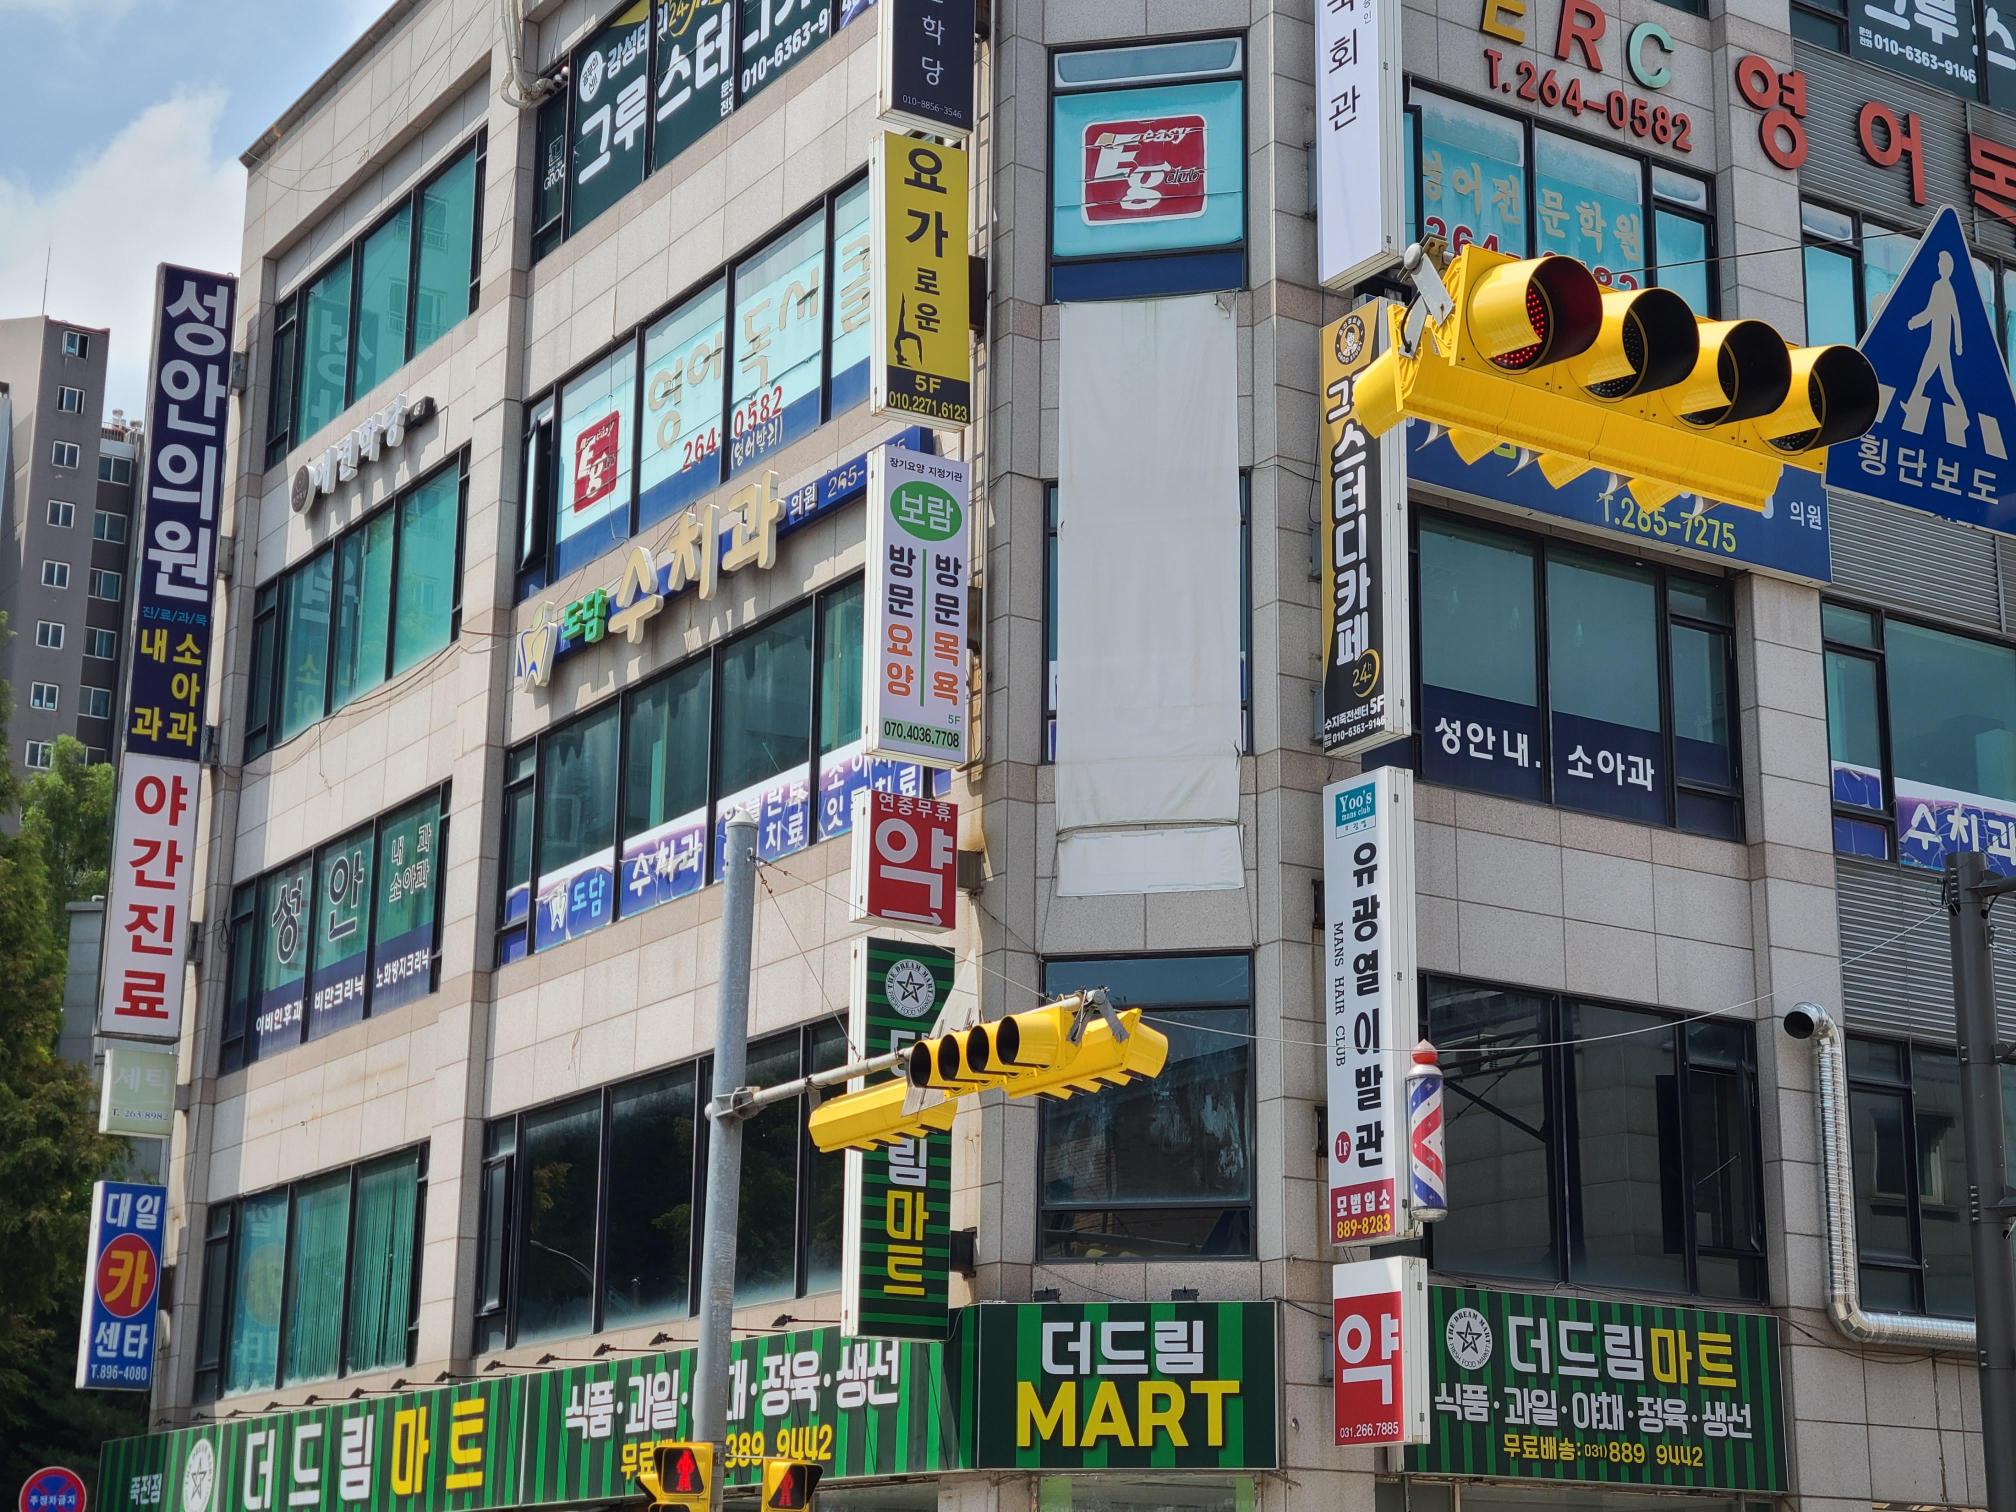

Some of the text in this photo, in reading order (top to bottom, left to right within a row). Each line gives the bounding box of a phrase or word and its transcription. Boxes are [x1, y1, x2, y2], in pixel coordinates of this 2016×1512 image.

[1874, 34, 1977, 85] 010-6363-9146
[902, 95, 962, 118] 010-8856-3546
[1484, 48, 1692, 152] T.264-0582
[915, 375, 942, 394] 5F
[888, 391, 968, 422] 010.2271.6123
[148, 281, 229, 602] 성안의원
[890, 457, 963, 483] 장기요양 지정기관
[1858, 434, 1999, 505] 횡단보도
[790, 483, 817, 518] 의원
[899, 490, 953, 533] 보람
[1328, 371, 1372, 666] 그스터디카페
[1790, 500, 1822, 531] 의원
[609, 470, 786, 644] 수치과
[887, 544, 916, 698] 방문요양
[884, 721, 960, 748] 070.4036.7708
[948, 714, 961, 725] 5F
[1568, 745, 1655, 792] 소아과
[879, 793, 951, 823] 연중무휴
[1340, 790, 1372, 813] Yoo's
[389, 858, 430, 903] 소아과
[875, 817, 954, 910] 약
[115, 775, 188, 1020] 야간진료
[571, 874, 605, 918] 도담
[1334, 921, 1346, 1067] MANS HAIR CLUB
[256, 999, 303, 1036] 이비인후과
[105, 1193, 160, 1230] 대일
[1337, 1189, 1390, 1217] 모범업소
[1337, 1212, 1391, 1239] 889-8283
[104, 1250, 148, 1308] 카
[95, 1322, 148, 1359] 센타
[1042, 1321, 1204, 1375] 더드림
[1338, 1313, 1399, 1405] 약
[1508, 1315, 1737, 1388] 더드림마트
[91, 1364, 147, 1381] T.896-4080
[1017, 1380, 1240, 1447] MART
[1340, 1422, 1399, 1438] 031.266.7885
